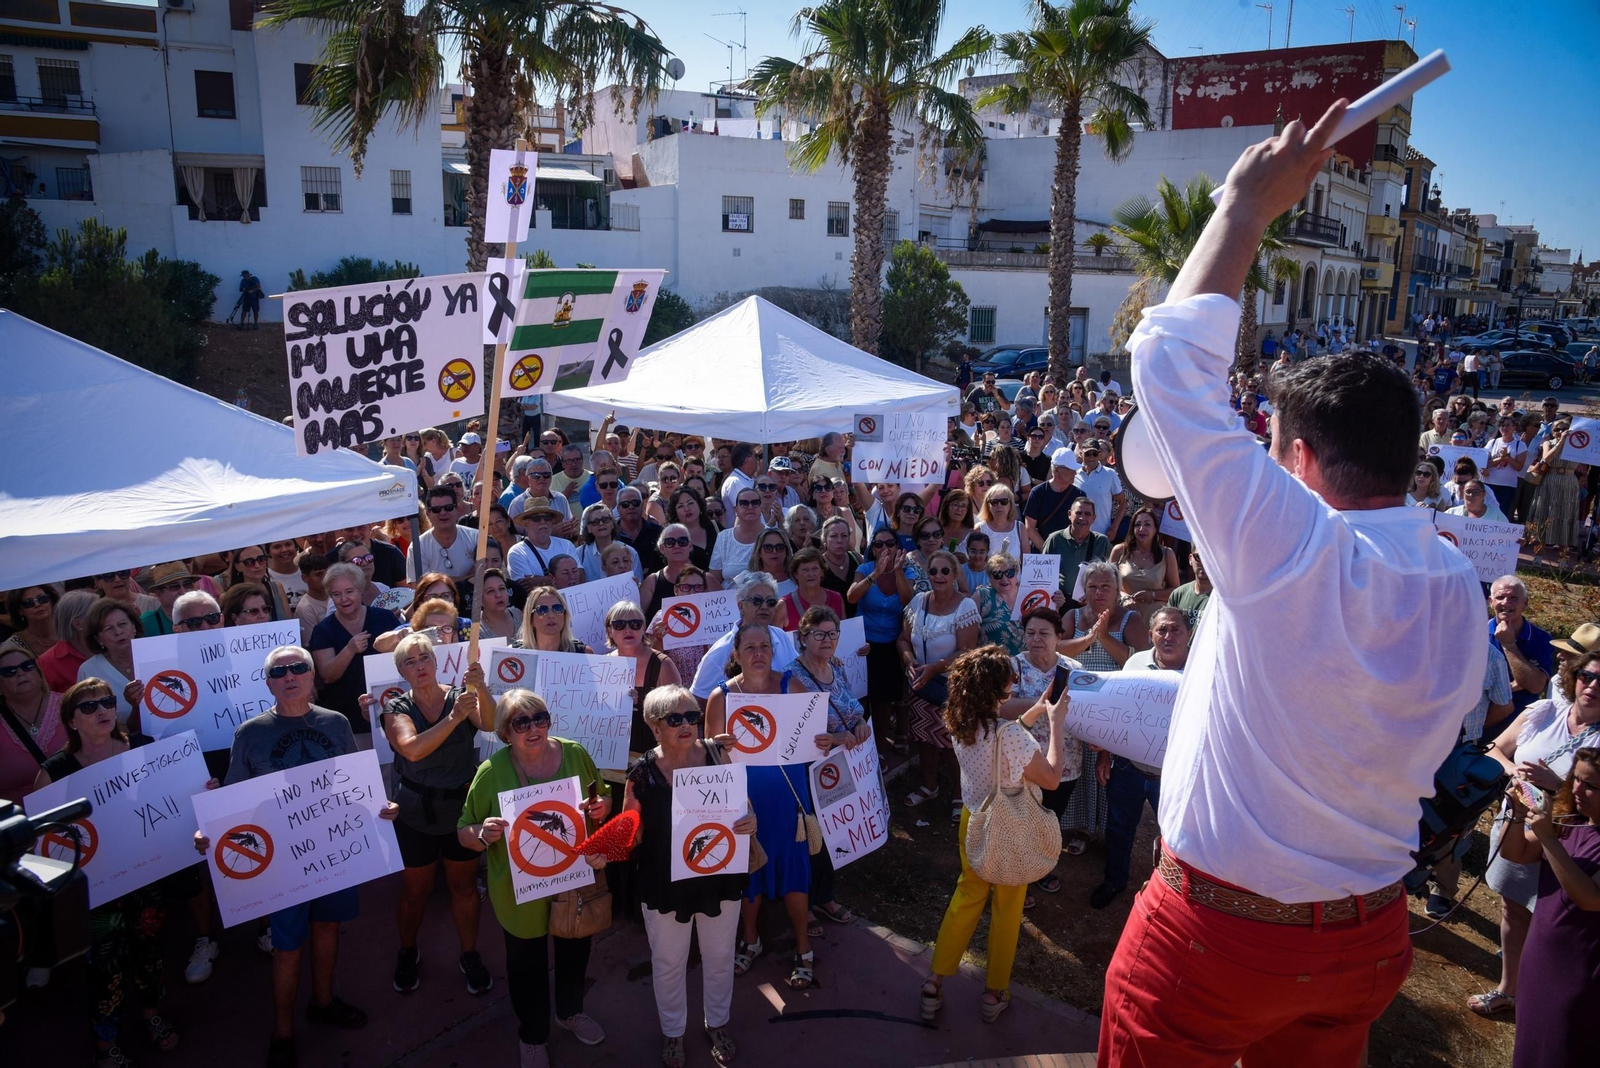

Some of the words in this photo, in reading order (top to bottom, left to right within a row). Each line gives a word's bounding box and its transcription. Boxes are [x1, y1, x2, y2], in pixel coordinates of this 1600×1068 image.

[286, 279, 432, 341] SOLUCIÓN
[442, 282, 478, 316] YA
[346, 324, 418, 369] UNA
[296, 358, 426, 420] MUERTE
[888, 429, 946, 442] QUEREMOS
[894, 442, 932, 458] VIVIR
[858, 458, 884, 471] CON
[596, 582, 632, 605] VIRUS
[706, 606, 731, 620] MÁS
[229, 630, 297, 654] QUEREMOS
[206, 674, 242, 694] VIVIR
[1108, 681, 1177, 706] TEMPRAN
[1065, 721, 1128, 746] VACUNA
[274, 784, 301, 810] ¡NO
[310, 768, 350, 793] MÁS
[676, 769, 734, 788] ¡VACUNA
[134, 794, 181, 837] YA!!
[287, 785, 373, 830] MUERTES!
[290, 838, 316, 860] ¡NO
[328, 814, 364, 842] MÁS
[304, 835, 370, 876] MIEDO!
